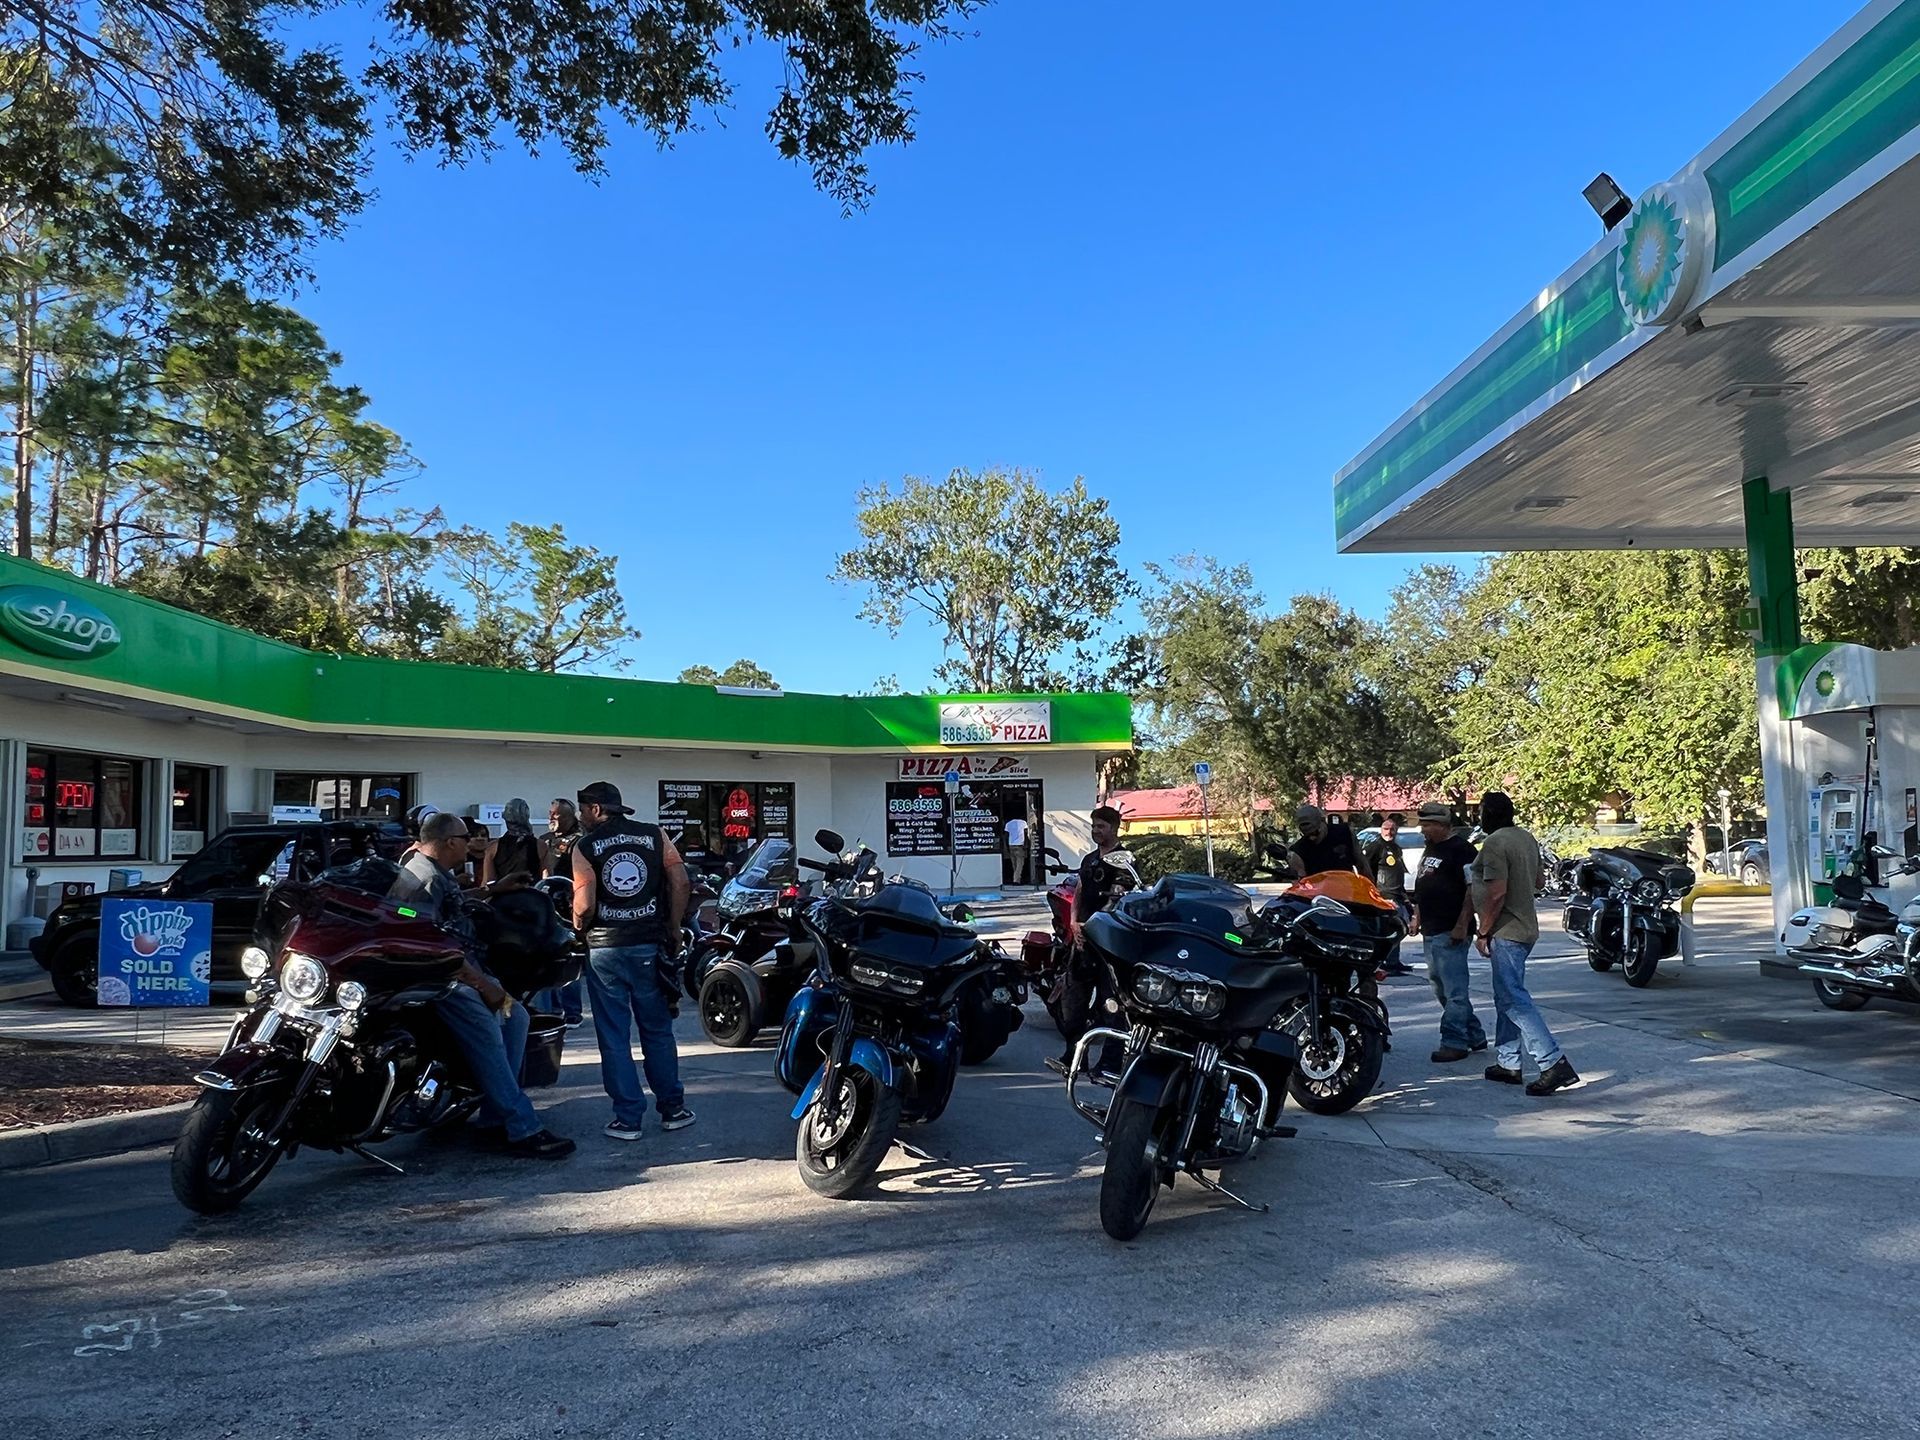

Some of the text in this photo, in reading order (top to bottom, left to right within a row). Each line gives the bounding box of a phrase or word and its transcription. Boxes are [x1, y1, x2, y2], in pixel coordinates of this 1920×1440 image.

[28, 600, 118, 652] shop
[1745, 612, 1752, 625] 1
[942, 725, 1048, 742] 586-3535 PIZZA
[901, 756, 972, 775] PIZZA
[1009, 766, 1029, 774] Slice
[56, 783, 93, 808] OPEN
[889, 799, 942, 812] 586-3535
[724, 824, 749, 838] OPEN
[598, 896, 657, 921] MOTORCYCLES
[120, 959, 173, 974] SOLD
[137, 976, 192, 990] HERE
